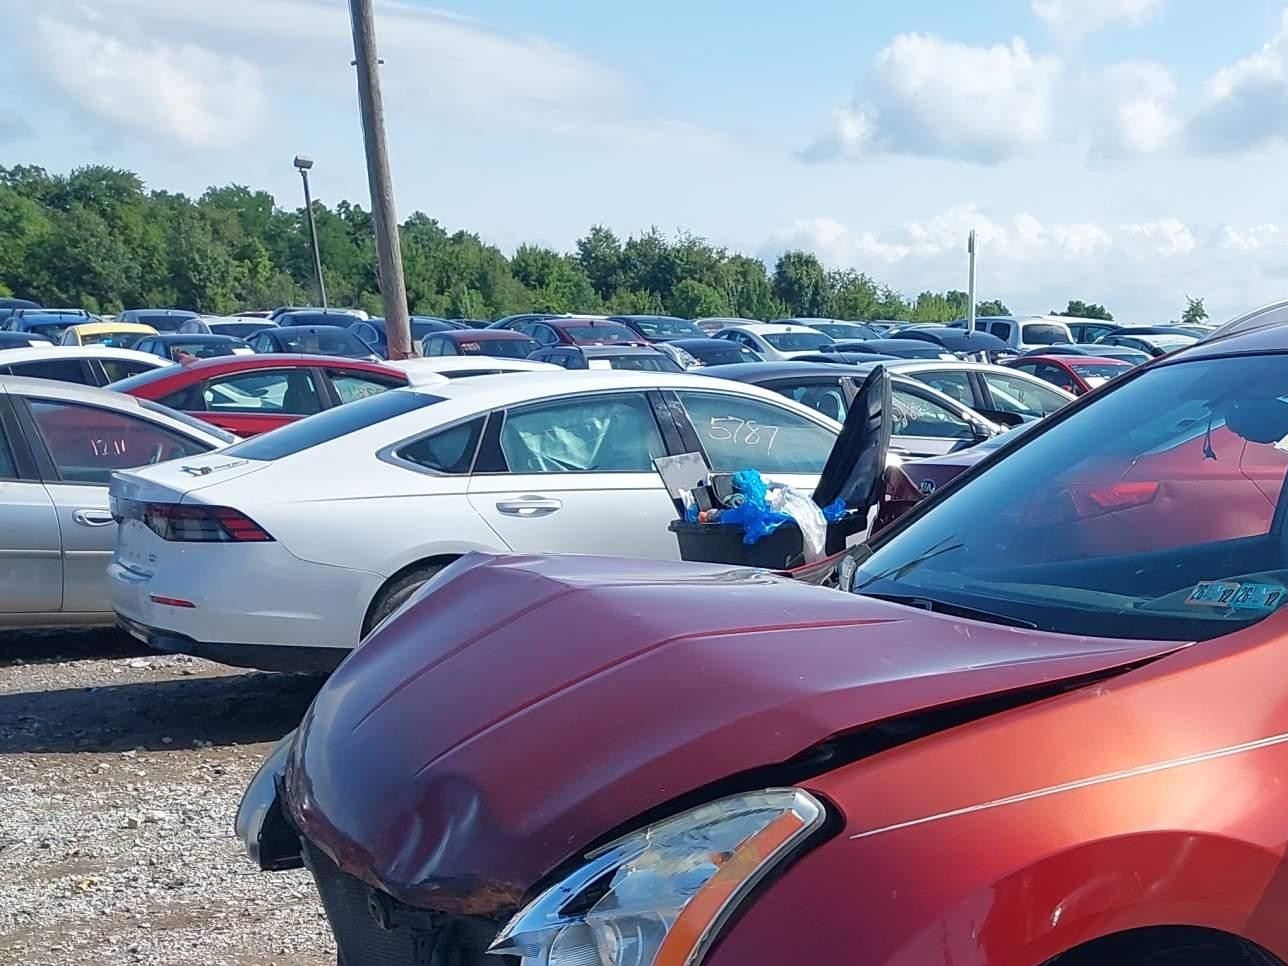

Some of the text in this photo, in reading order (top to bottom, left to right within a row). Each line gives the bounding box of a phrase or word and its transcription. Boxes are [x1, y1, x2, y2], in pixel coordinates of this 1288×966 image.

[708, 416, 779, 456] 5787
[1217, 588, 1234, 603] 12
[1263, 591, 1280, 607] 12
